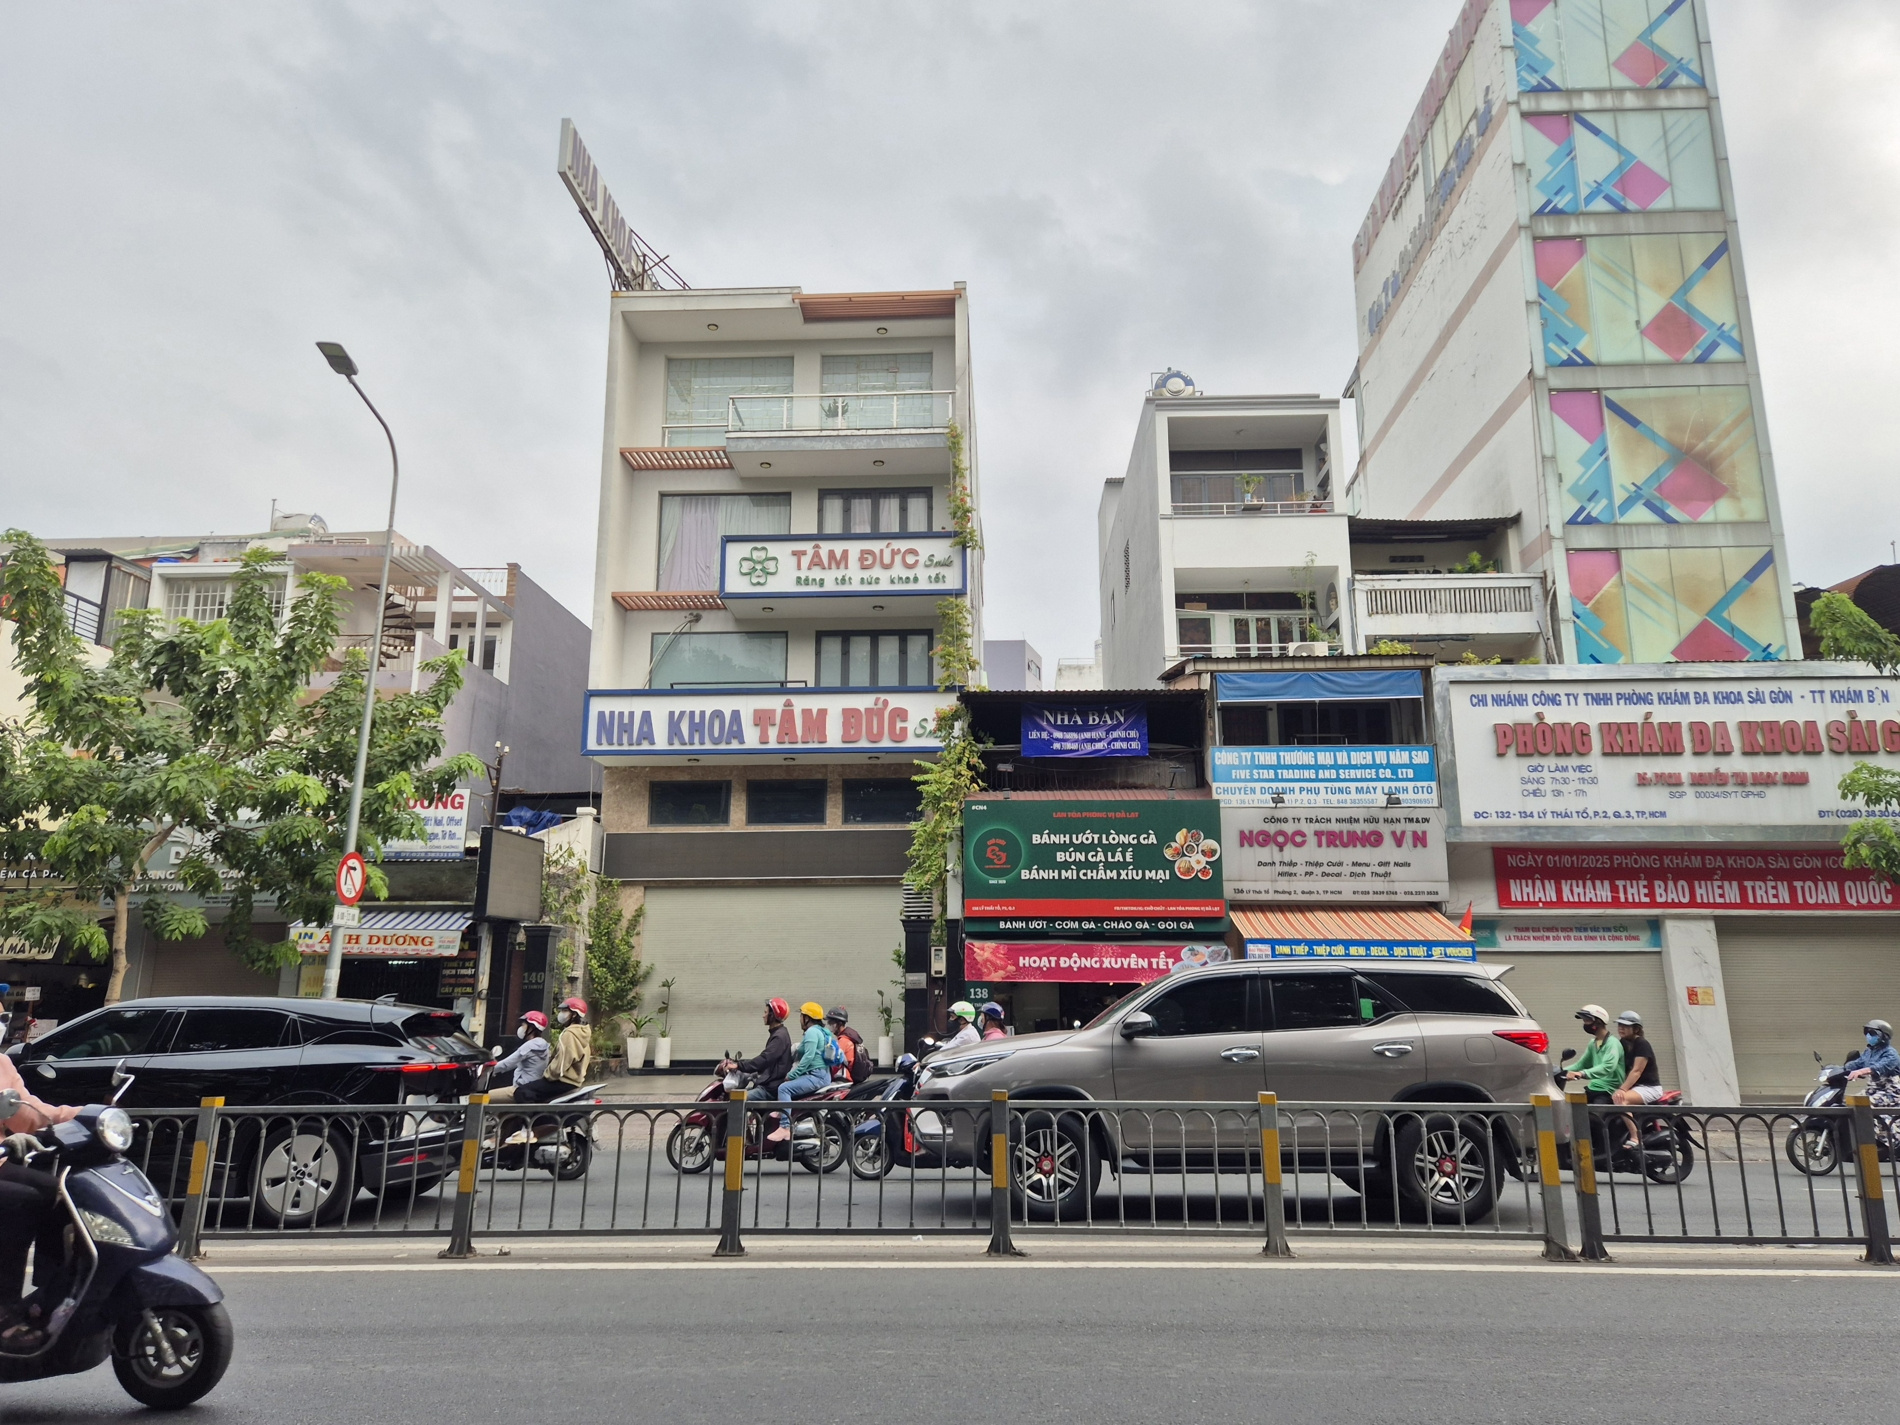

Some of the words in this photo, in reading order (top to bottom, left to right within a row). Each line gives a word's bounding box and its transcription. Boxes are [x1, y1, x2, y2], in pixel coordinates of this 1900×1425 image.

[792, 543, 849, 570] TÂM
[858, 542, 919, 569] ĐỨC
[795, 575, 825, 588] Răng
[834, 573, 853, 586] tốt
[859, 574, 881, 585] sức
[927, 571, 947, 584] tốt
[1470, 693, 1488, 708] CHI
[1492, 691, 1529, 707] NHÁNH
[1532, 690, 1562, 707] CÔNG
[1565, 693, 1579, 706] TY
[1583, 692, 1613, 706] TNHH
[1616, 689, 1654, 706] PHÒNG
[1657, 689, 1690, 705] KHÁM
[1693, 691, 1710, 705] ĐA
[1713, 691, 1744, 705] KHOA
[1747, 687, 1765, 705] SÀI
[1769, 687, 1793, 704] GÒN
[1809, 690, 1825, 704] TT
[1830, 687, 1864, 704] KHÁM
[596, 710, 656, 746] NHA
[667, 709, 746, 746] KHOA
[753, 698, 828, 744] TÂM
[841, 697, 909, 743] ĐỨC
[1043, 708, 1083, 725] NHÀ
[1088, 706, 1125, 725] BÁN
[1494, 711, 1593, 756] PHÒNG
[1599, 711, 1685, 756] KHÁM
[1689, 721, 1735, 754] ĐA
[1738, 720, 1825, 754] KHOA
[1215, 750, 1239, 765] CÔNG
[1241, 752, 1252, 765] TY
[1411, 750, 1429, 764] SAO
[1232, 769, 1251, 779] FIVE
[1253, 769, 1275, 779] STAR
[1277, 769, 1316, 779] TRADING
[1318, 769, 1337, 779] AND
[1339, 769, 1377, 779] SERVICE
[1398, 768, 1414, 779] LTD
[1527, 764, 1544, 773] GIỜ
[1548, 764, 1569, 773] LÀM
[1571, 765, 1593, 774] VIỆC
[1520, 776, 1545, 785] SÁNG
[1550, 777, 1570, 785] 7h30
[1577, 777, 1598, 785] 11h30
[1215, 784, 1256, 795] CHUYÊN
[1260, 786, 1295, 795] DOANH
[1299, 786, 1320, 797] PHỤ
[1324, 784, 1351, 795] TÙNG
[1552, 789, 1564, 797] 13h
[1575, 789, 1587, 797] 17h
[1669, 791, 1687, 799] SGP
[1263, 815, 1289, 824] CÔNG
[1304, 815, 1332, 824] TRÁCH
[1335, 816, 1360, 826] NHIỆM
[1363, 815, 1380, 824] HỮU
[1383, 817, 1401, 826] HẠN
[1474, 811, 1492, 819] ĐC:
[1537, 809, 1547, 819] LÝ
[1551, 808, 1573, 819] THÁI
[1649, 810, 1667, 819] HCM
[1818, 810, 1834, 818] ĐT:
[1836, 809, 1863, 819] (028)
[1032, 829, 1070, 844] BÁNH
[1072, 829, 1100, 844] ƯỚT
[1102, 829, 1138, 844] LÒNG
[1139, 830, 1157, 844] GÀ
[1239, 830, 1307, 853] NGỌC
[1313, 830, 1384, 848] TRUNG
[1056, 847, 1086, 862] BÚN
[1088, 847, 1106, 862] GÀ
[1107, 847, 1124, 862] LÁ
[1507, 852, 1543, 868] NGÀY
[1546, 854, 1611, 868] 01/01/2025
[1613, 852, 1660, 868] PHÒNG
[1663, 852, 1702, 868] KHÁM
[1705, 856, 1725, 868] ĐA
[1727, 856, 1766, 868] KHOA
[1768, 853, 1789, 868] SÀI
[1793, 853, 1822, 869] GÒN
[1304, 860, 1324, 869] Thiệp
[1021, 865, 1058, 880] BÁNH
[1061, 865, 1077, 880] MÌ
[1119, 865, 1143, 880] XÍU
[1145, 869, 1170, 883] MẠI
[1349, 871, 1368, 879] Dịch
[1370, 870, 1391, 879] Thuật
[1561, 874, 1612, 902] KHÁM
[1615, 873, 1650, 902] THẺ
[1654, 873, 1690, 903] BẢO
[1694, 871, 1741, 904] HIỂM
[1744, 875, 1790, 904] TRÊN
[1793, 875, 1841, 904] TOÀN
[1055, 918, 1079, 929] CƠM
[298, 932, 314, 940] IN
[367, 934, 435, 947] DƯƠNG
[1275, 945, 1291, 955] DANH
[1349, 946, 1366, 956] MENU
[1370, 946, 1389, 956] DECAL
[1019, 956, 1057, 971] HOẠT
[1059, 952, 1100, 971] ĐỘNG
[1102, 954, 1148, 969] XUYÊN
[1151, 951, 1174, 969] TẾT
[523, 972, 545, 983] 140
[969, 988, 989, 999] 138
